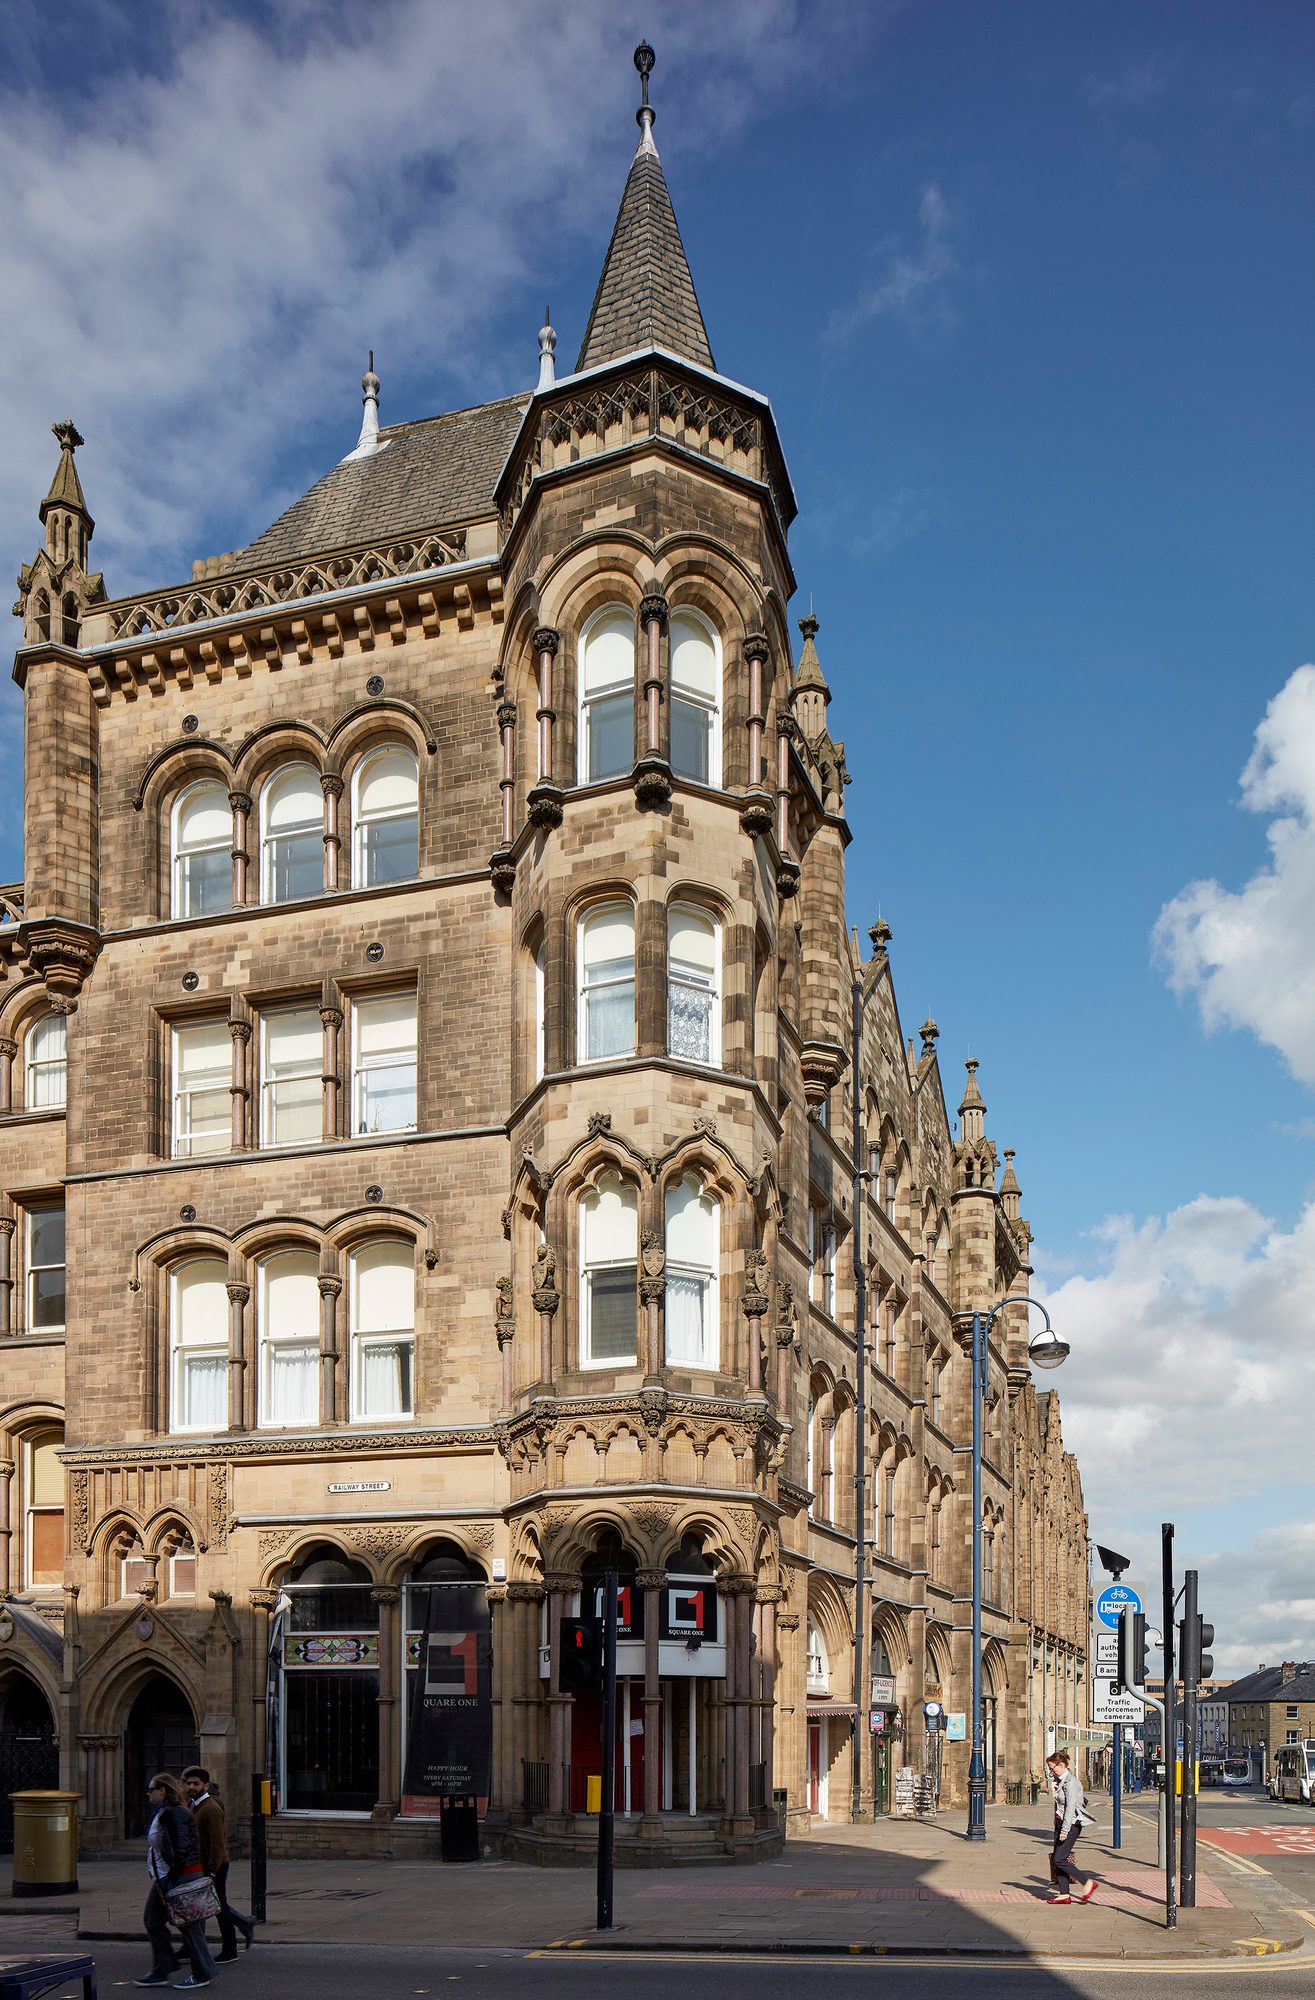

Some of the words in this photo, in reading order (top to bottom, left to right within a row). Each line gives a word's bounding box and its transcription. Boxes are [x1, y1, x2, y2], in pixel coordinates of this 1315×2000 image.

[1099, 1666, 1105, 1674] 8
[423, 1698, 457, 1708] QUARE
[457, 1698, 479, 1707] ONE
[1107, 1698, 1131, 1706] Traffic
